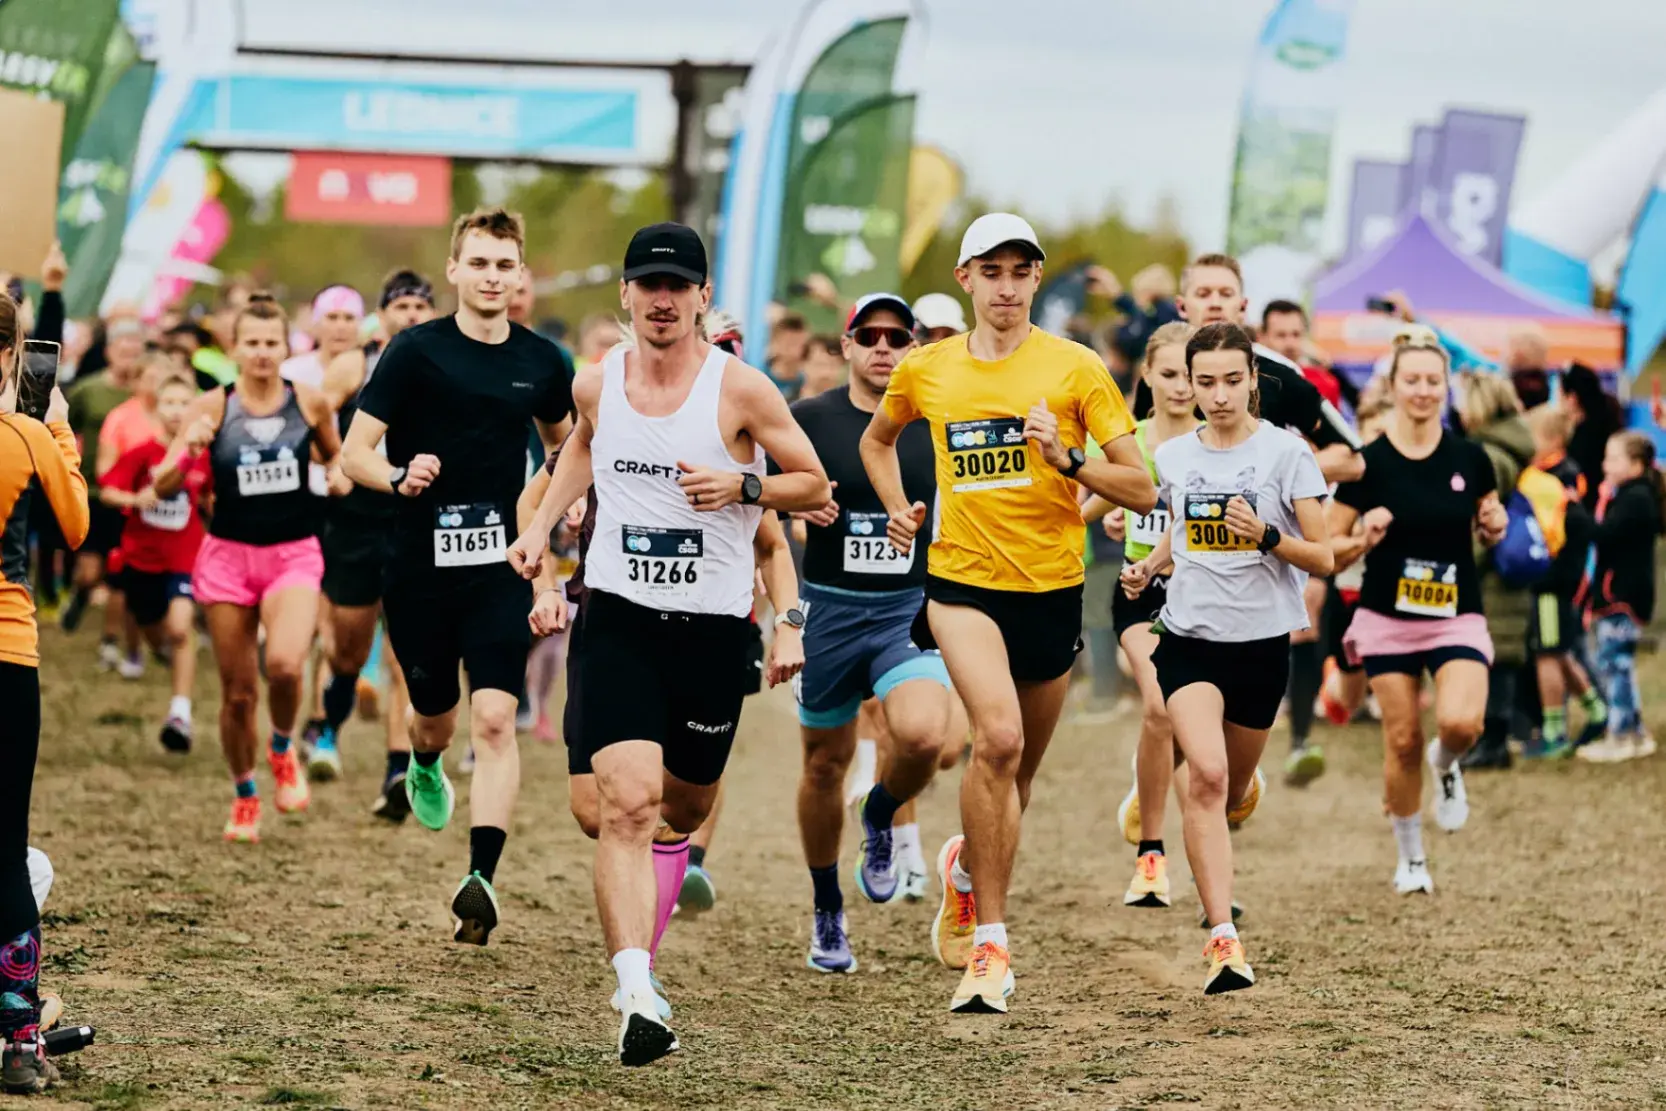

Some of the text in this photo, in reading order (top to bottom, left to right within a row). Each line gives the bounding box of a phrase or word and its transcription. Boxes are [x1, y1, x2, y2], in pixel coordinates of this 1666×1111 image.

[613, 459, 674, 478] CRAFT
[953, 449, 1025, 478] 30020
[441, 529, 498, 553] 31651
[628, 558, 697, 584] 31266
